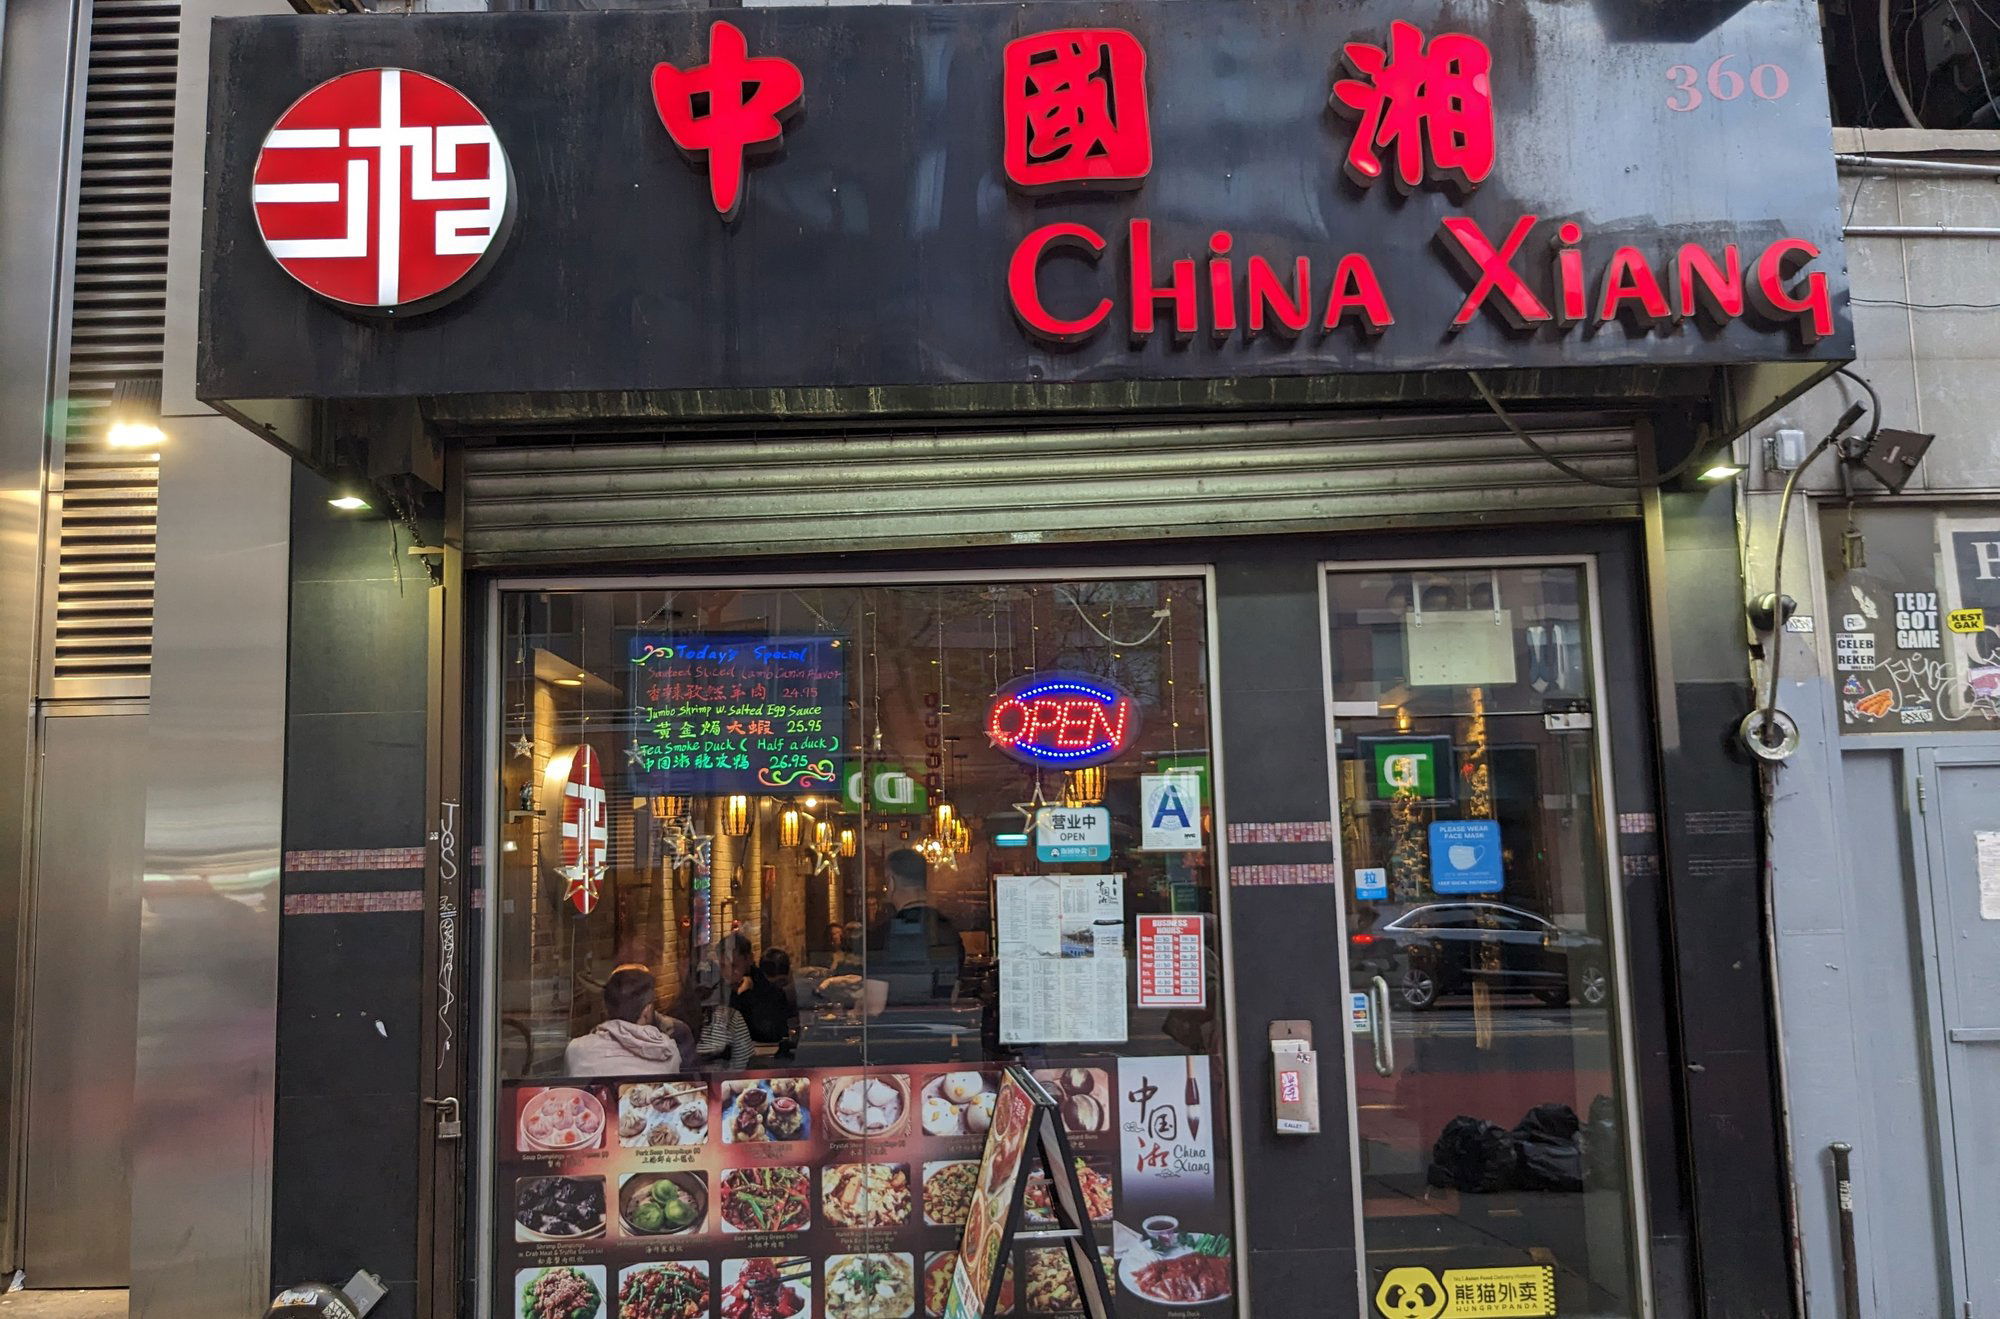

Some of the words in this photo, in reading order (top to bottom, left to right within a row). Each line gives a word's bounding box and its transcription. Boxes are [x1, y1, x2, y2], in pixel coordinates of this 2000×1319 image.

[1665, 54, 1790, 112] 360
[1894, 592, 1937, 611] TEDZ
[1896, 611, 1938, 630] GOT
[1951, 612, 1982, 622] KEST
[1954, 621, 1979, 630] GAK
[1837, 639, 1874, 649] CELEB
[1897, 630, 1940, 649] GAME
[1838, 655, 1875, 665] REKER
[782, 687, 818, 698] 24.95
[646, 705, 676, 722] Jumbo
[728, 703, 763, 716] Salted
[767, 703, 786, 718] Egg
[787, 704, 822, 717] Sauce
[787, 719, 822, 733] 25.95
[990, 698, 1129, 746] OPEN
[704, 738, 736, 752] Duck
[790, 741, 799, 750] a
[769, 754, 809, 769] 26.95
[1151, 784, 1191, 828] A
[1052, 814, 1096, 829] 营业中
[1060, 832, 1086, 841] OPEN
[1152, 919, 1188, 927] BUSINESS
[1173, 1144, 1206, 1159] China
[1173, 1160, 1210, 1175] Xiang
[1455, 1282, 1537, 1304] 熊猫外卖
[1456, 1303, 1537, 1312] HUNGRYPANDA
